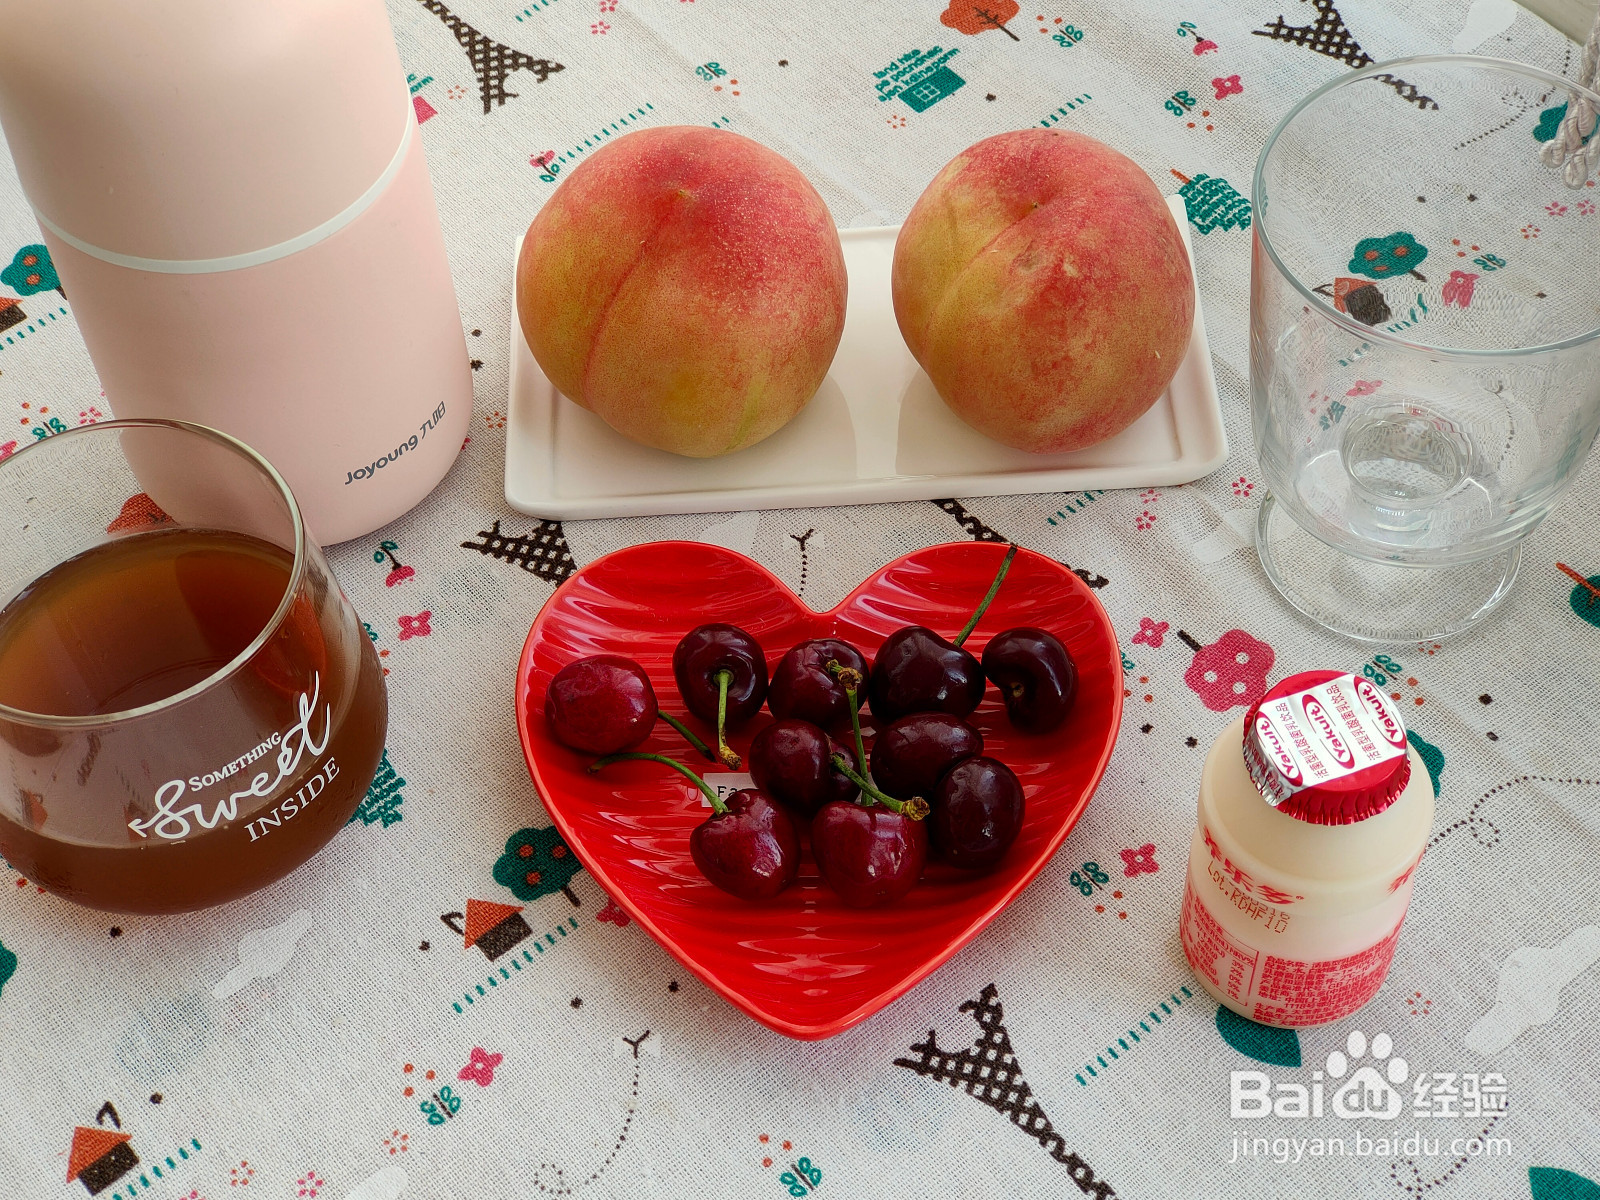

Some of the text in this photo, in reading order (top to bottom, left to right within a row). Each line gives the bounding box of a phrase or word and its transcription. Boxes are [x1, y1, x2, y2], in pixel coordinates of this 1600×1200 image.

[344, 434, 419, 486] Joyoung
[1275, 702, 1329, 779] 活菌型乳酸菌乳饮品
[1310, 704, 1346, 760] Yakult
[1326, 684, 1381, 761] 活菌型乳酸菌乳饮品
[1362, 684, 1399, 740] Yakult
[188, 731, 282, 792] SOMETHING
[1260, 720, 1295, 776] Yakult
[243, 756, 341, 843] INSIDE
